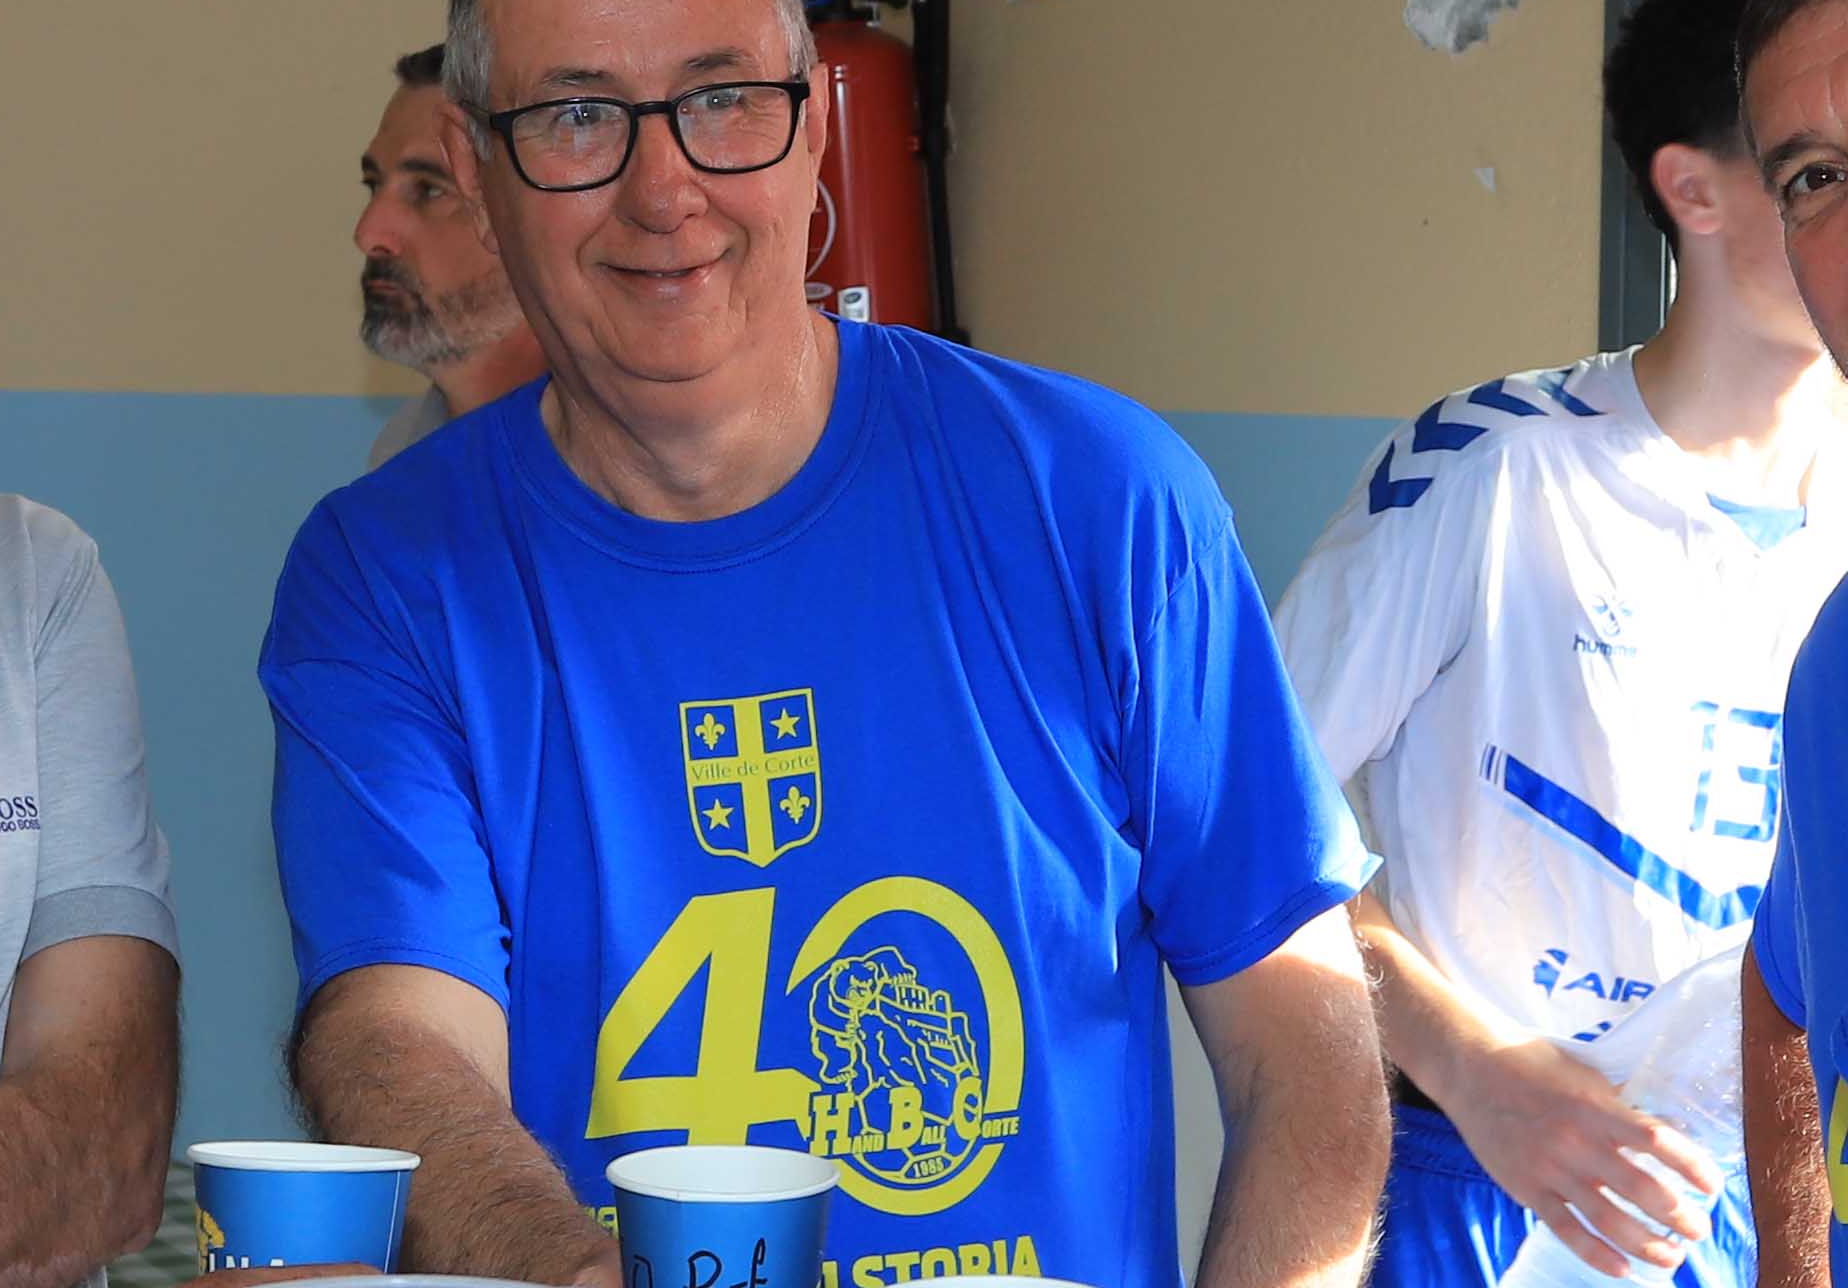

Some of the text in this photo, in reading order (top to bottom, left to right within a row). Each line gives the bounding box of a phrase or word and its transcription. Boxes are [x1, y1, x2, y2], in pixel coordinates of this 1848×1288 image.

[692, 754, 814, 781] Ville de Corte
[18, 818, 41, 831] BOSS
[585, 875, 1025, 1216] 40
[912, 1157, 945, 1179] 1985
